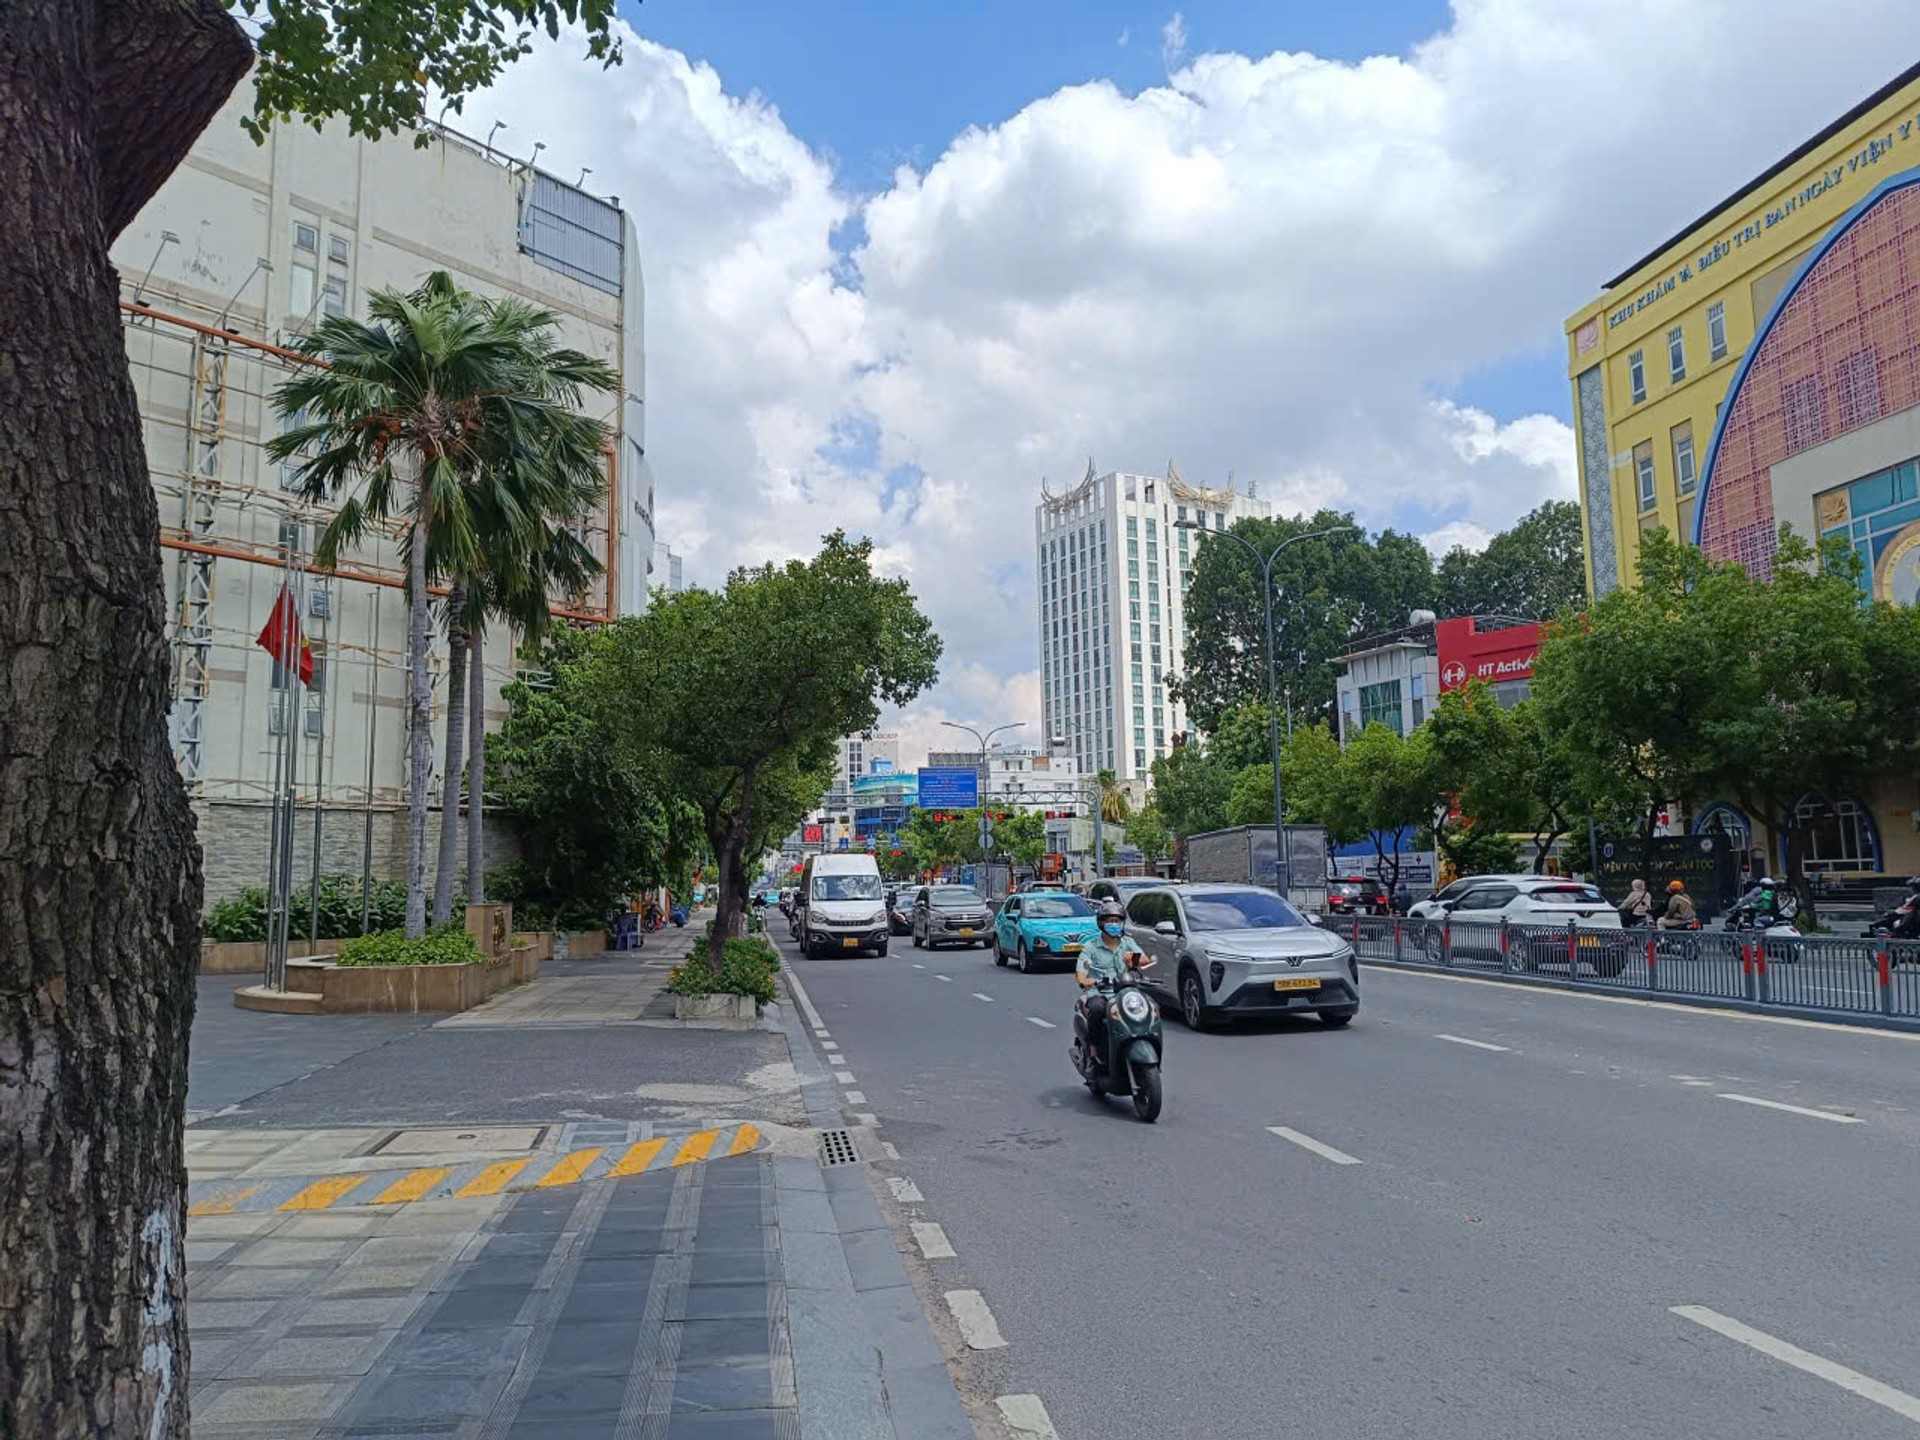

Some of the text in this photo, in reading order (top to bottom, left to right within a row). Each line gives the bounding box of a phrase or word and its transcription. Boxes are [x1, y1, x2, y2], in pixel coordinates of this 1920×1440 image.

[1609, 302, 1635, 329] KHU
[1636, 275, 1676, 312] KHÁM
[1698, 238, 1731, 272] ĐIỀU
[1733, 219, 1762, 248] TRỊ
[1765, 196, 1797, 229] BAN
[1799, 165, 1844, 208] NGÀY
[1847, 132, 1893, 172] VIỆN
[1898, 119, 1912, 140] Y
[1478, 663, 1494, 676] HT
